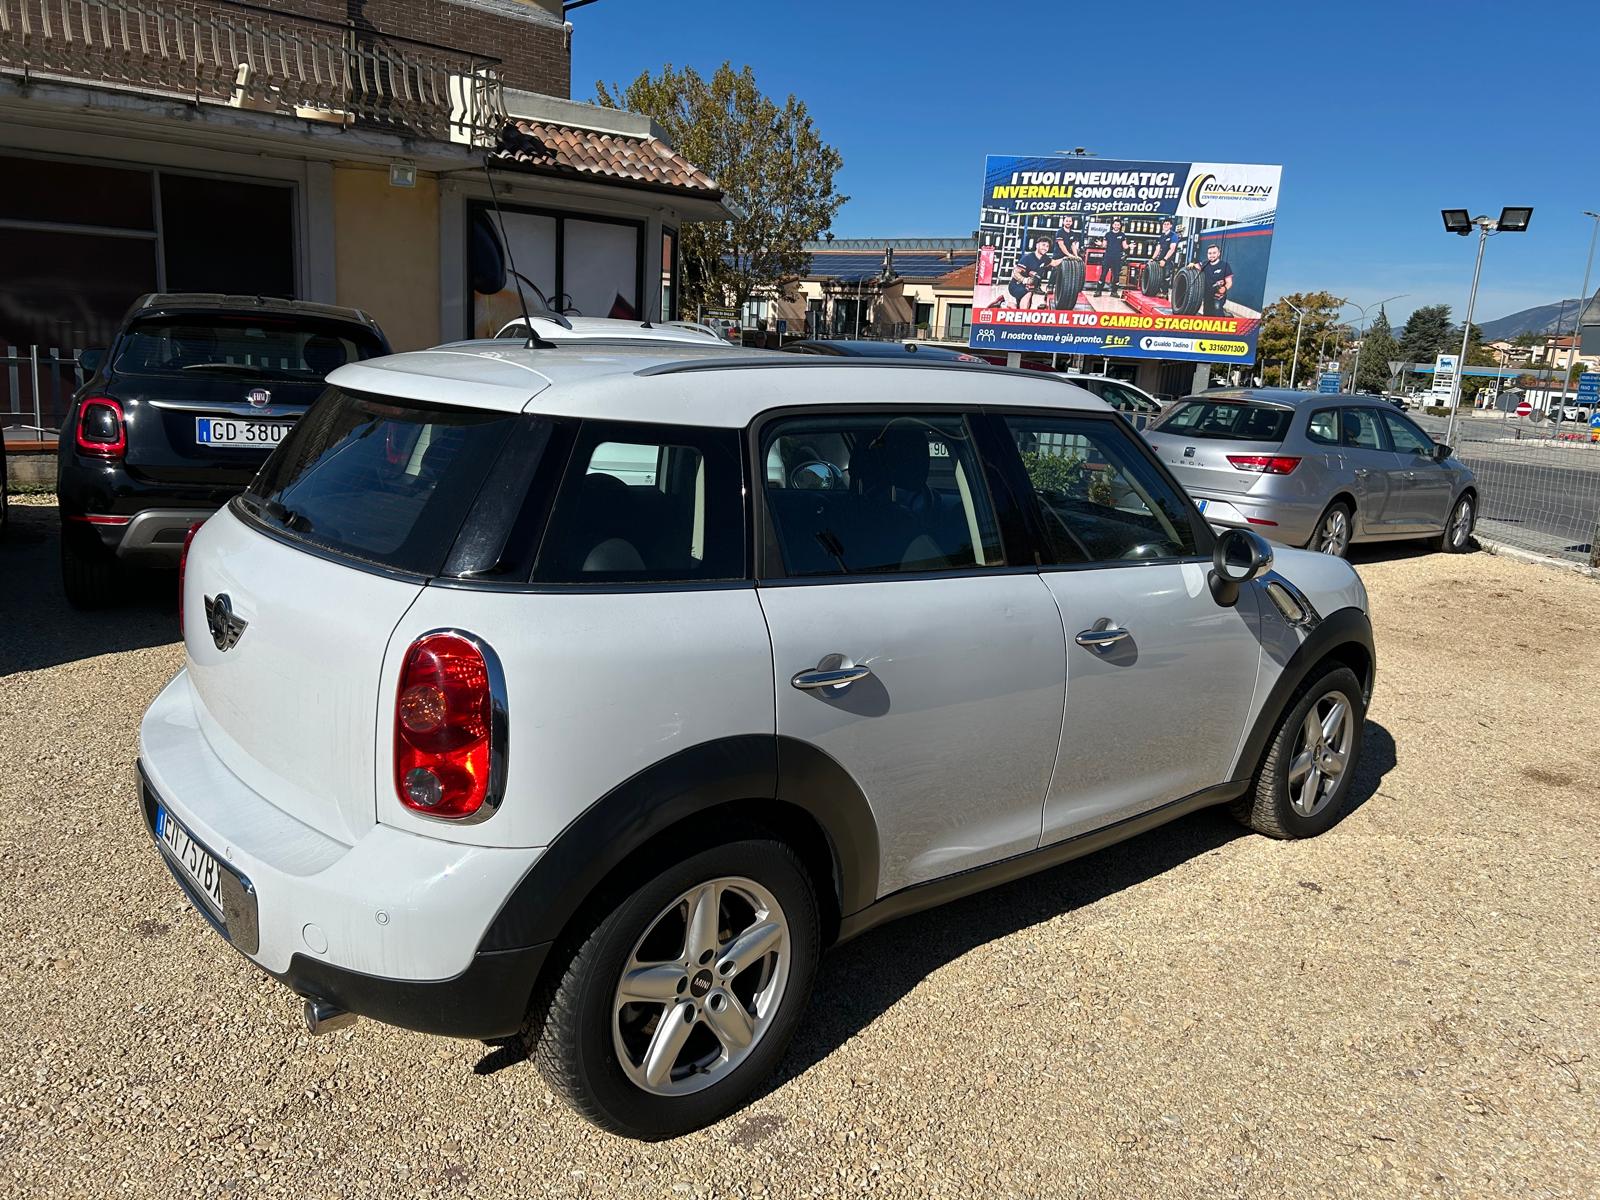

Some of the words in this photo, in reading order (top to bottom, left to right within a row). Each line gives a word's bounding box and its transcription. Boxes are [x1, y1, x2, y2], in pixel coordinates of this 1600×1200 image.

[1011, 172, 1019, 185] I
[1020, 172, 1062, 185] TUOI
[1063, 172, 1175, 187] PNEUMATICI
[992, 186, 1073, 199] INVERNALI
[1074, 187, 1112, 199] SONO
[1113, 185, 1136, 199] GIÀ
[1138, 187, 1164, 200] QUI
[1204, 183, 1273, 194] RINALDINI
[1015, 200, 1029, 211] Tu
[1030, 202, 1055, 211] cosa
[1058, 200, 1081, 211] stai
[1083, 201, 1161, 214] aspettando?
[996, 311, 1057, 324] PRENOTA
[1058, 313, 1070, 325] IL
[1072, 314, 1098, 326] TUO
[1100, 316, 1153, 329] CAMBIO
[1154, 317, 1238, 332] STAGIONALE
[1001, 331, 1007, 339] Il
[1007, 332, 1033, 340] nostro
[1034, 333, 1054, 341] team
[1061, 333, 1073, 344] già
[1074, 335, 1104, 344] pronto.
[1105, 335, 1113, 344] E
[1114, 335, 1131, 345] tu?
[1153, 340, 1172, 348] Gualdo
[1172, 341, 1189, 349] Tadino
[1208, 343, 1245, 353] 3316071300
[253, 392, 266, 402] FIAT
[213, 422, 236, 440] GD
[1171, 459, 1205, 467] LEON
[693, 977, 711, 990] MINI
